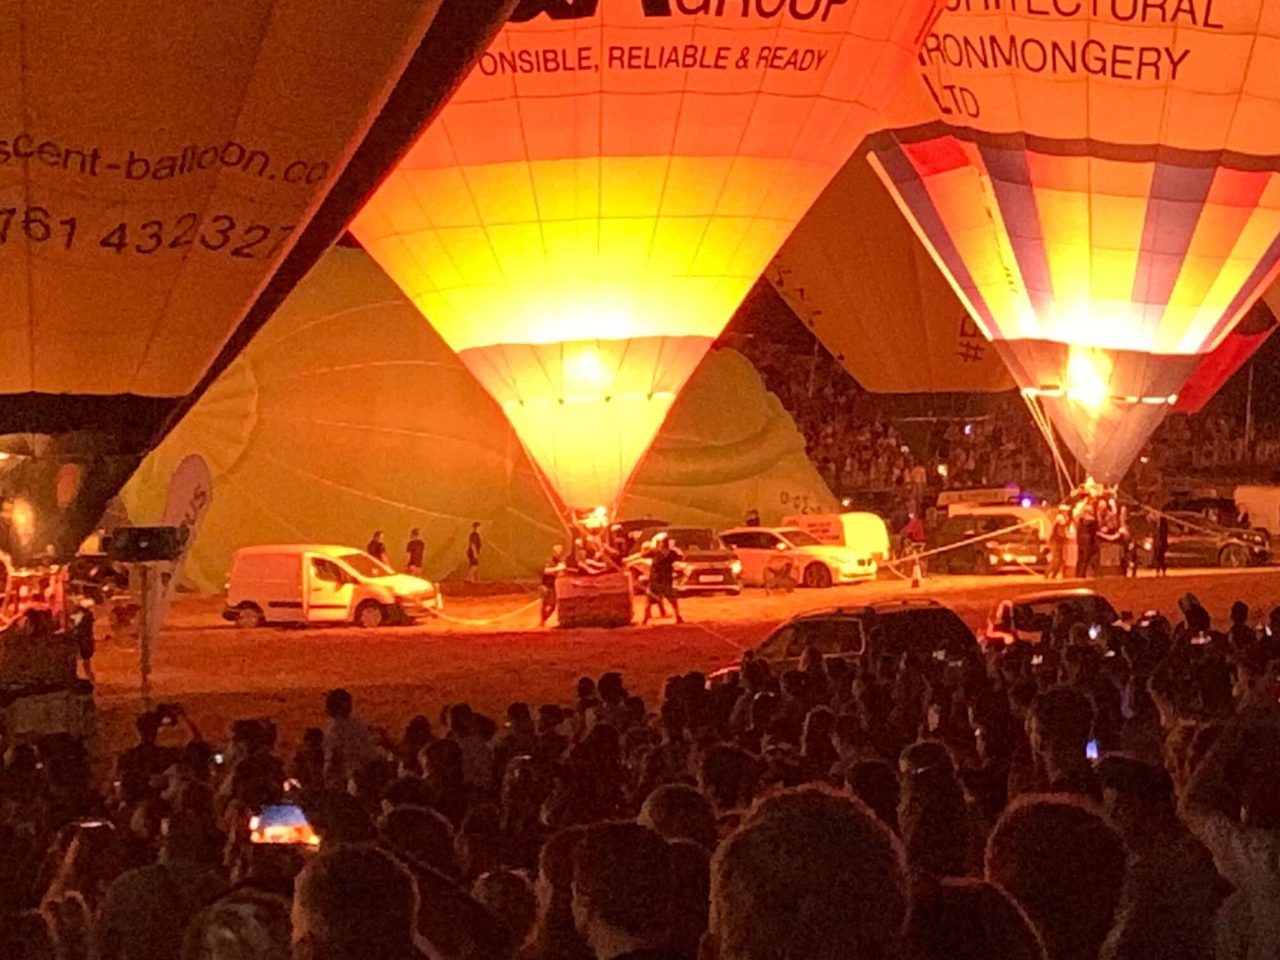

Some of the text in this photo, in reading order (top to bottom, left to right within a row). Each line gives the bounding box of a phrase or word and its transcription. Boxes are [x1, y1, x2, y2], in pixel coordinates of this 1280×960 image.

[608, 45, 732, 71] RELIABLE
[736, 46, 750, 69] &
[756, 46, 829, 72] READY
